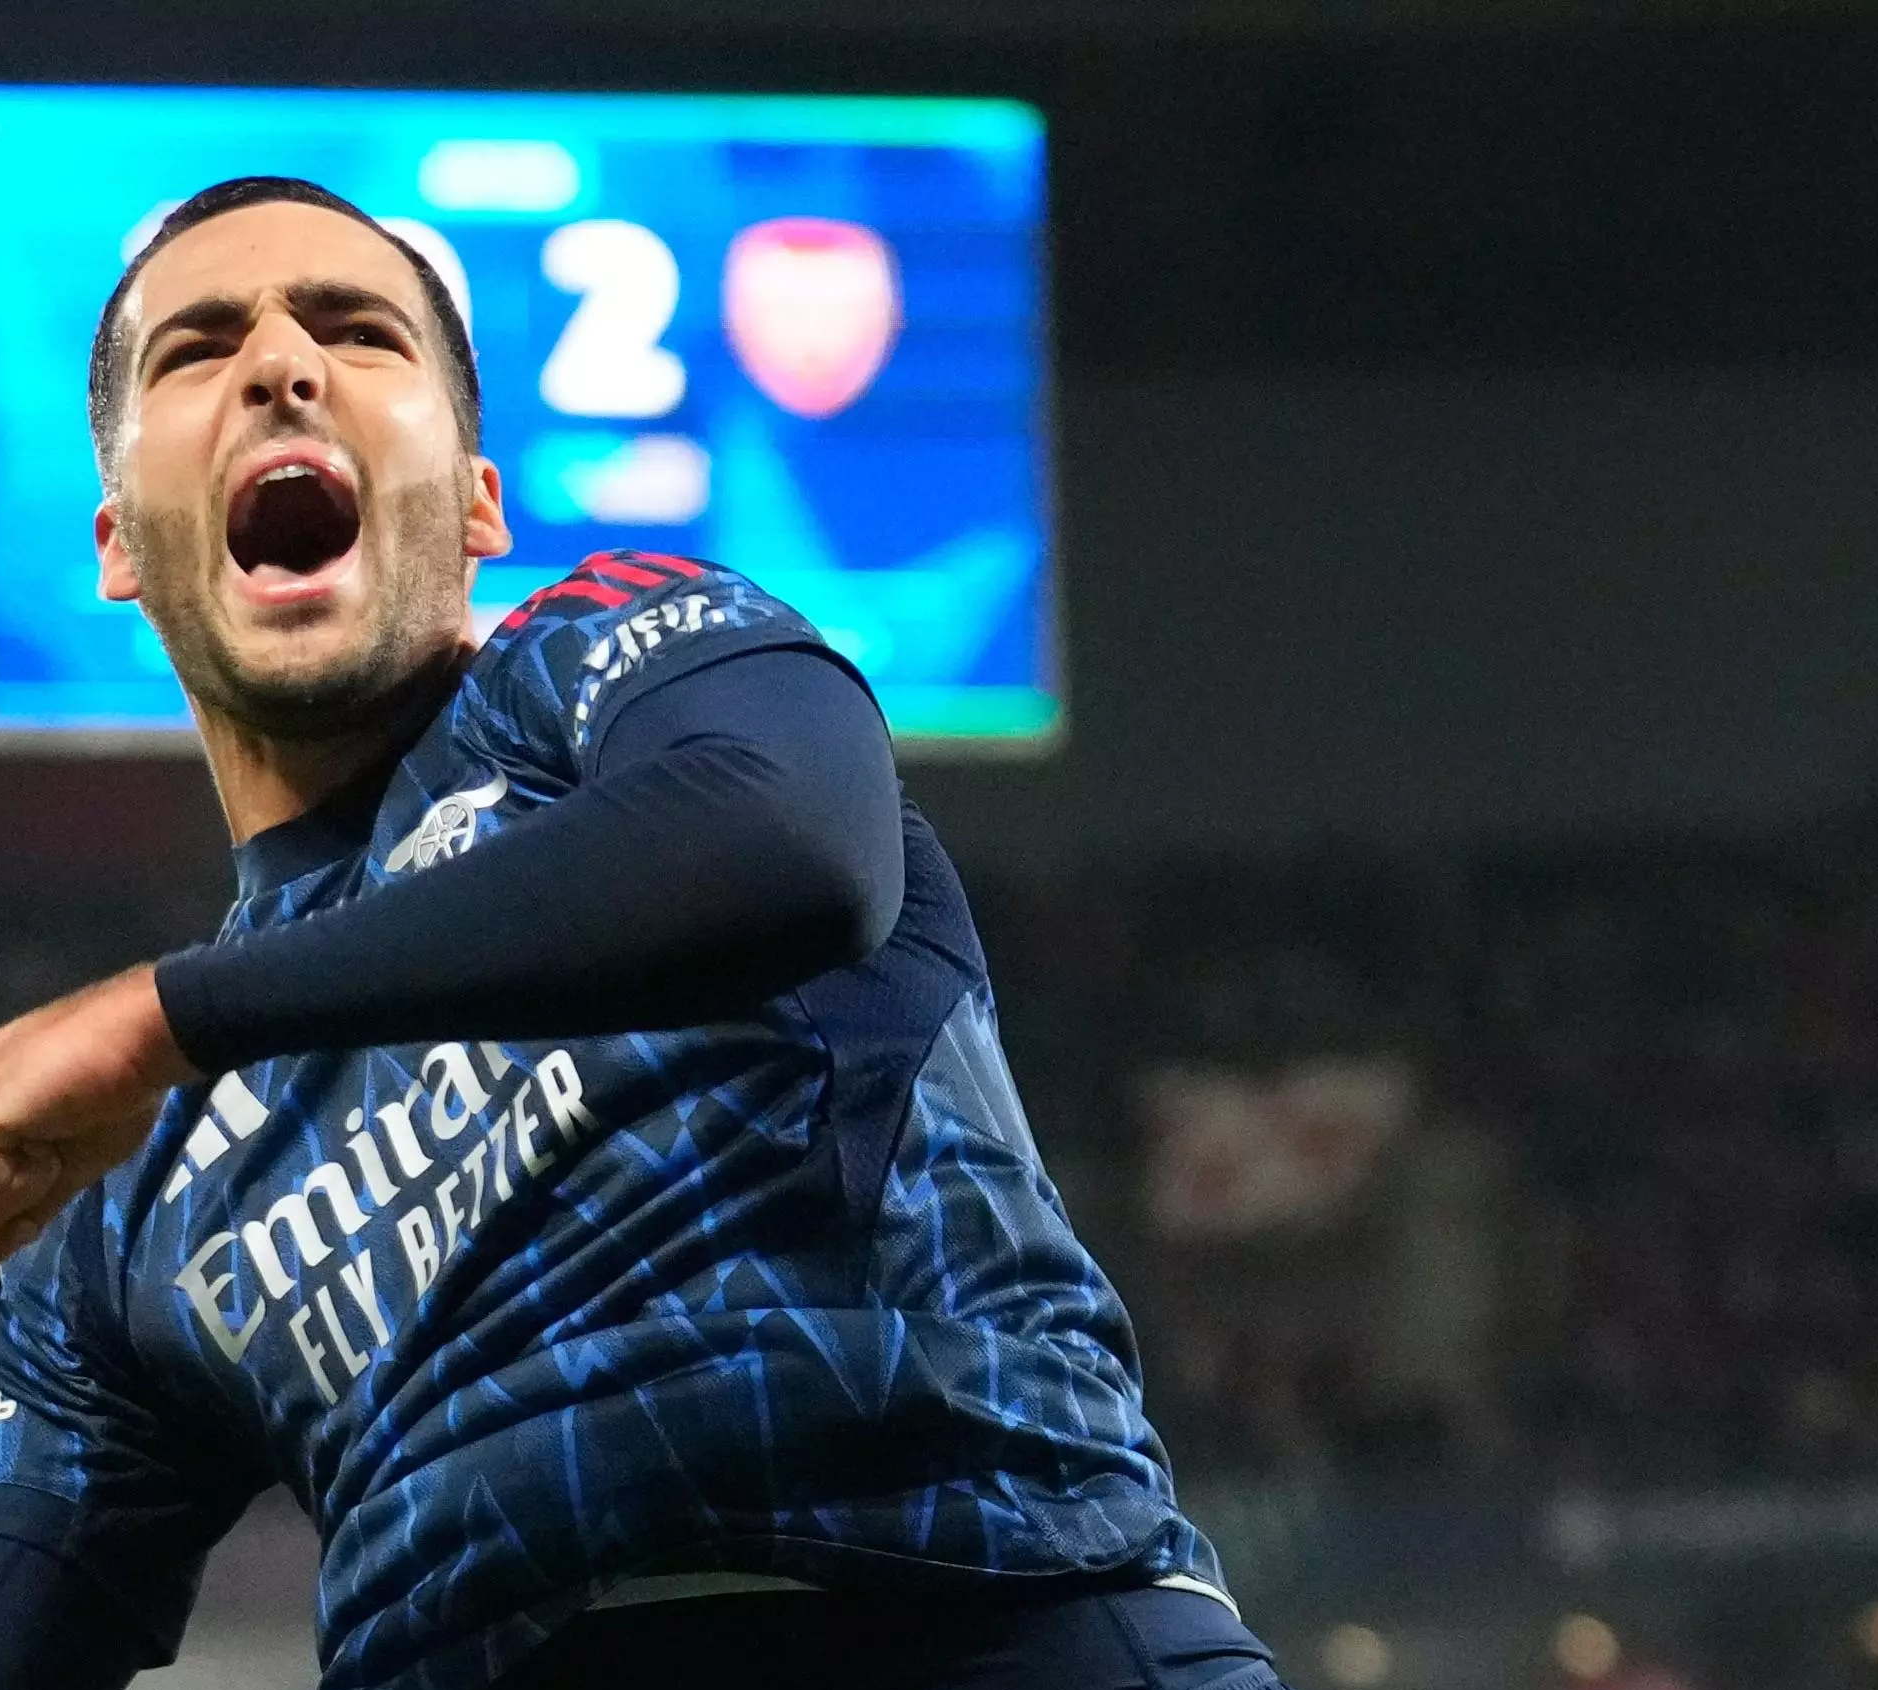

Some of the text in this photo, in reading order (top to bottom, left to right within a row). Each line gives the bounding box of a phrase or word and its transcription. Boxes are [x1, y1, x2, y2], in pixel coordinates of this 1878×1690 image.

[540, 217, 684, 418] 2
[174, 1041, 512, 1364] Emira
[288, 1049, 601, 1405] FLY BETTER
